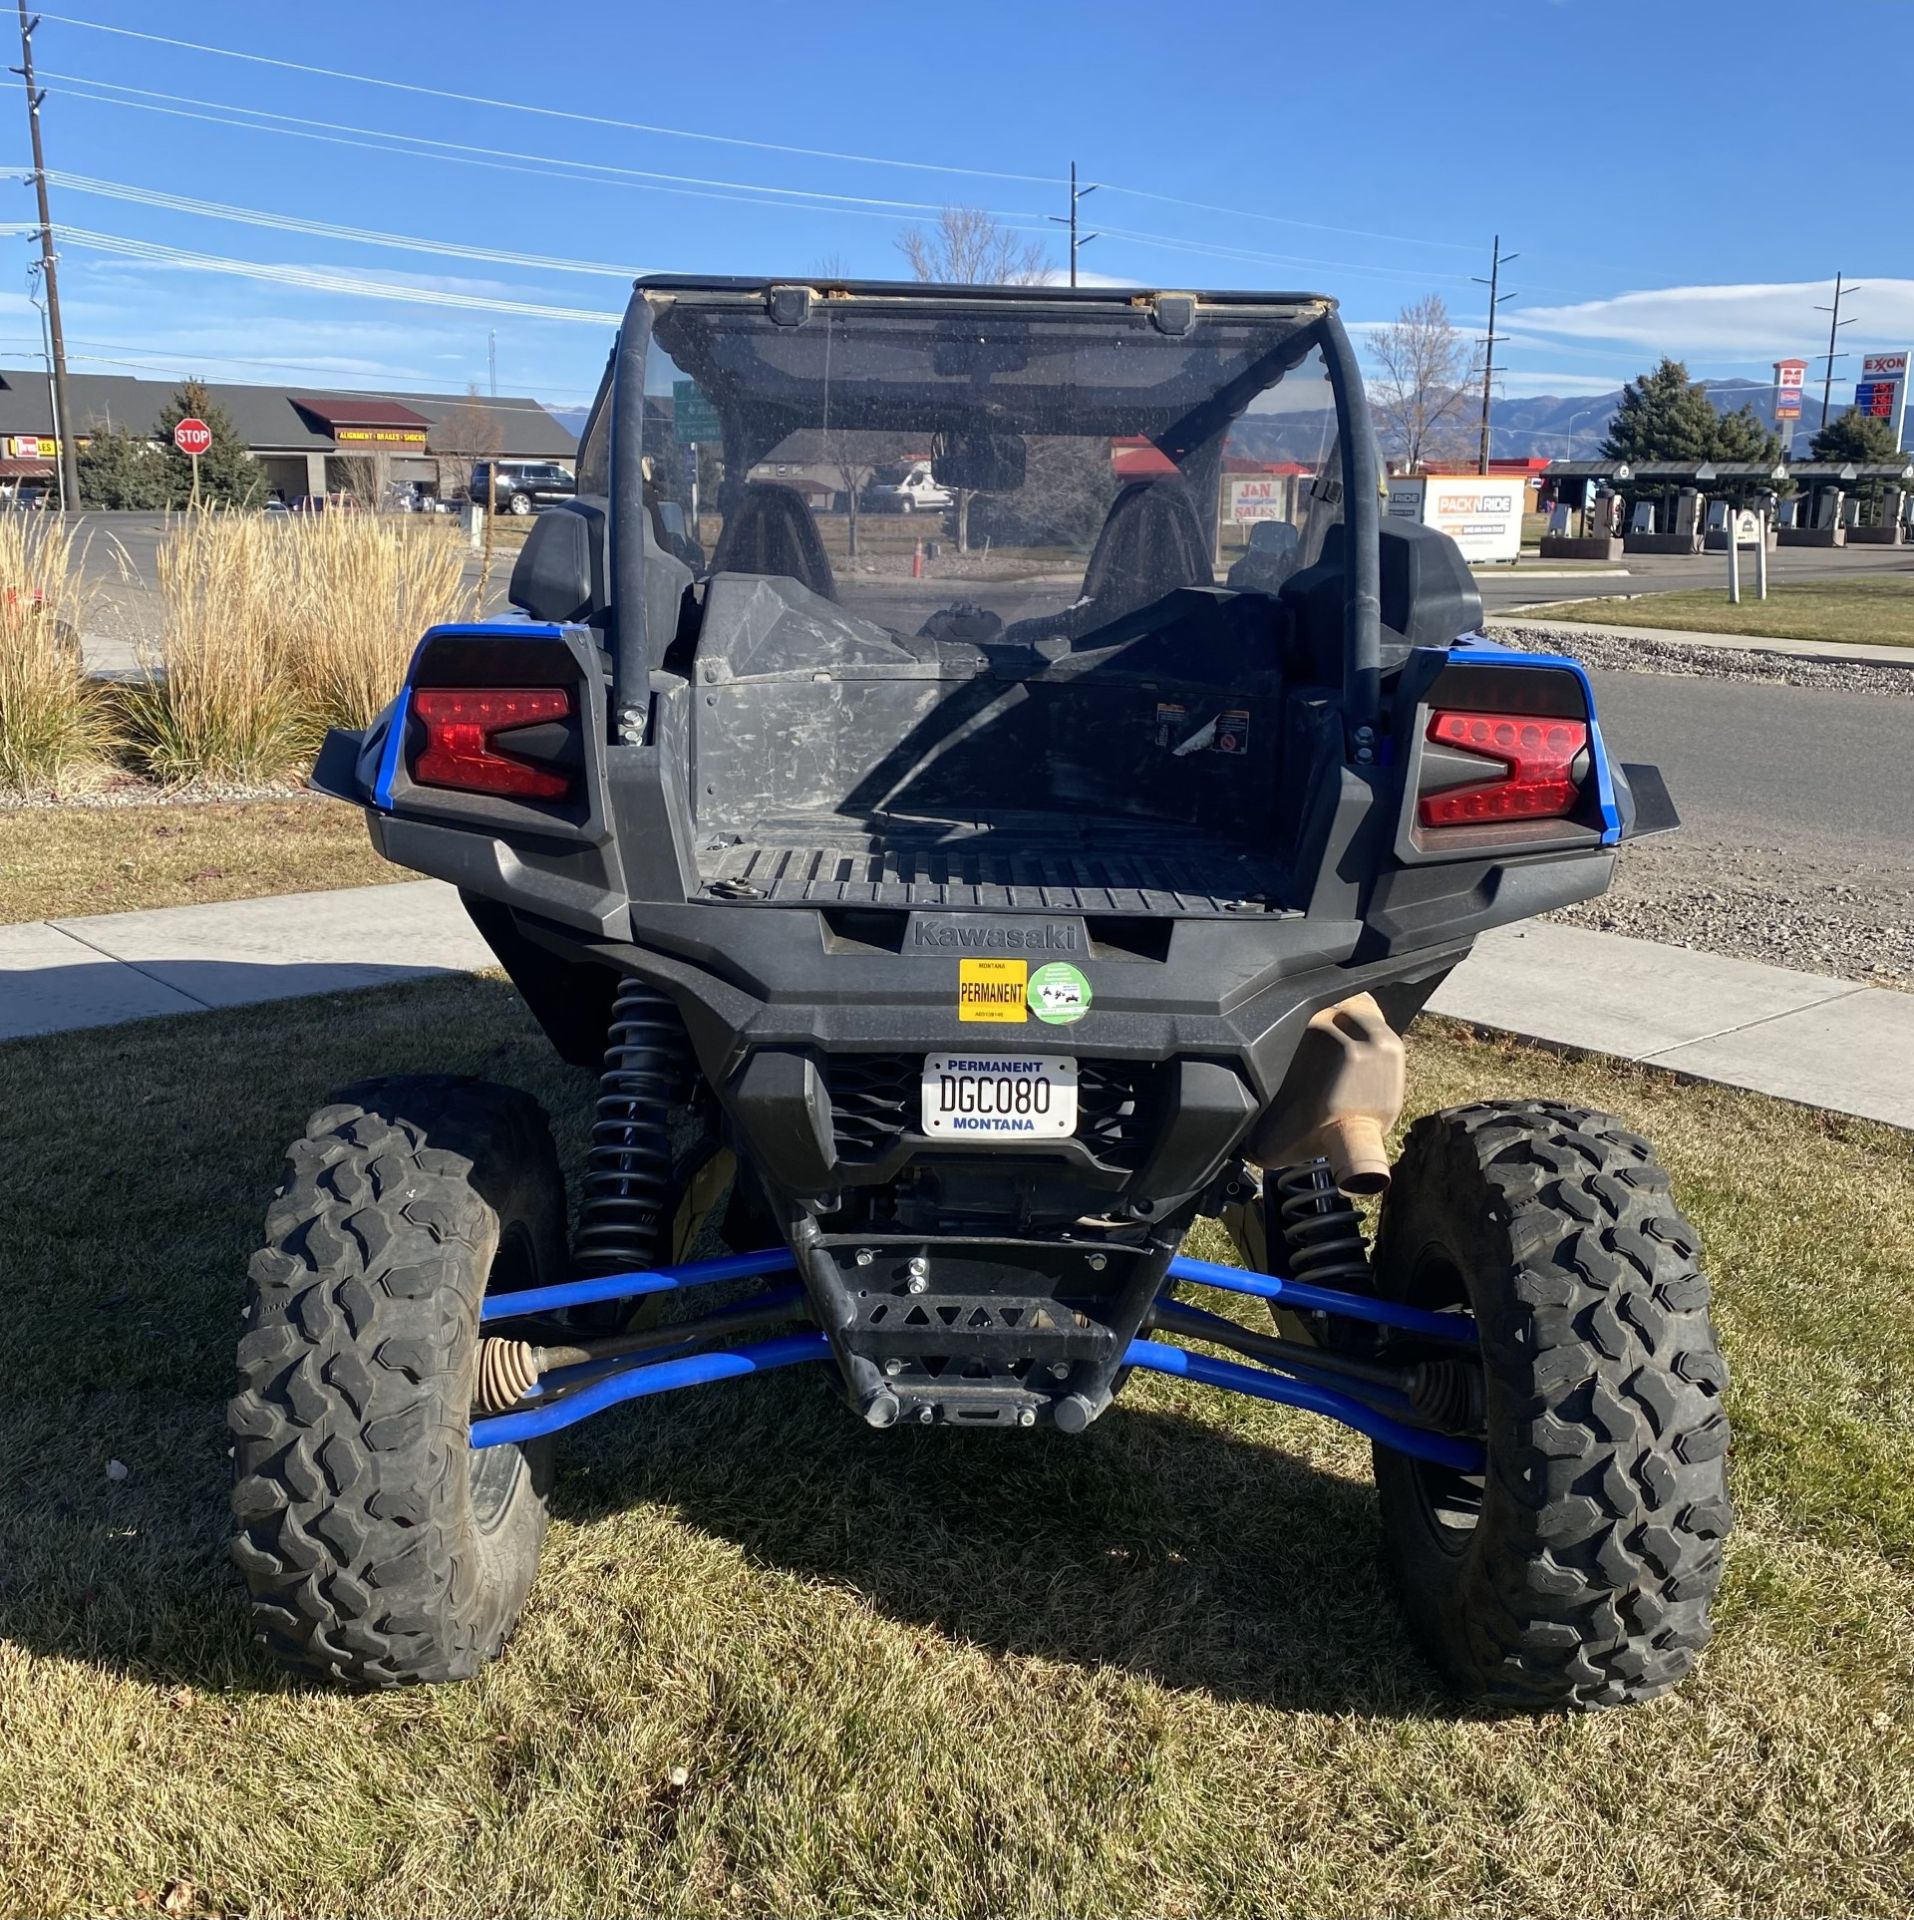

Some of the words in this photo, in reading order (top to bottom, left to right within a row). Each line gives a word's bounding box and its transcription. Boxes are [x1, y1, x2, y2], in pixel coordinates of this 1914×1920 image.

[1864, 357, 1905, 372] EXXON
[178, 429, 208, 443] STOP
[340, 431, 373, 440] ALIGNMENT
[1241, 483, 1271, 498] J&N
[1234, 506, 1276, 518] SALES
[915, 921, 1077, 950] Kawasaki
[961, 982, 1024, 1003] PERMANENT
[948, 1060, 1043, 1073] PERMANENT
[940, 1074, 1050, 1114] DGC080
[953, 1117, 1035, 1131] MONTANA
